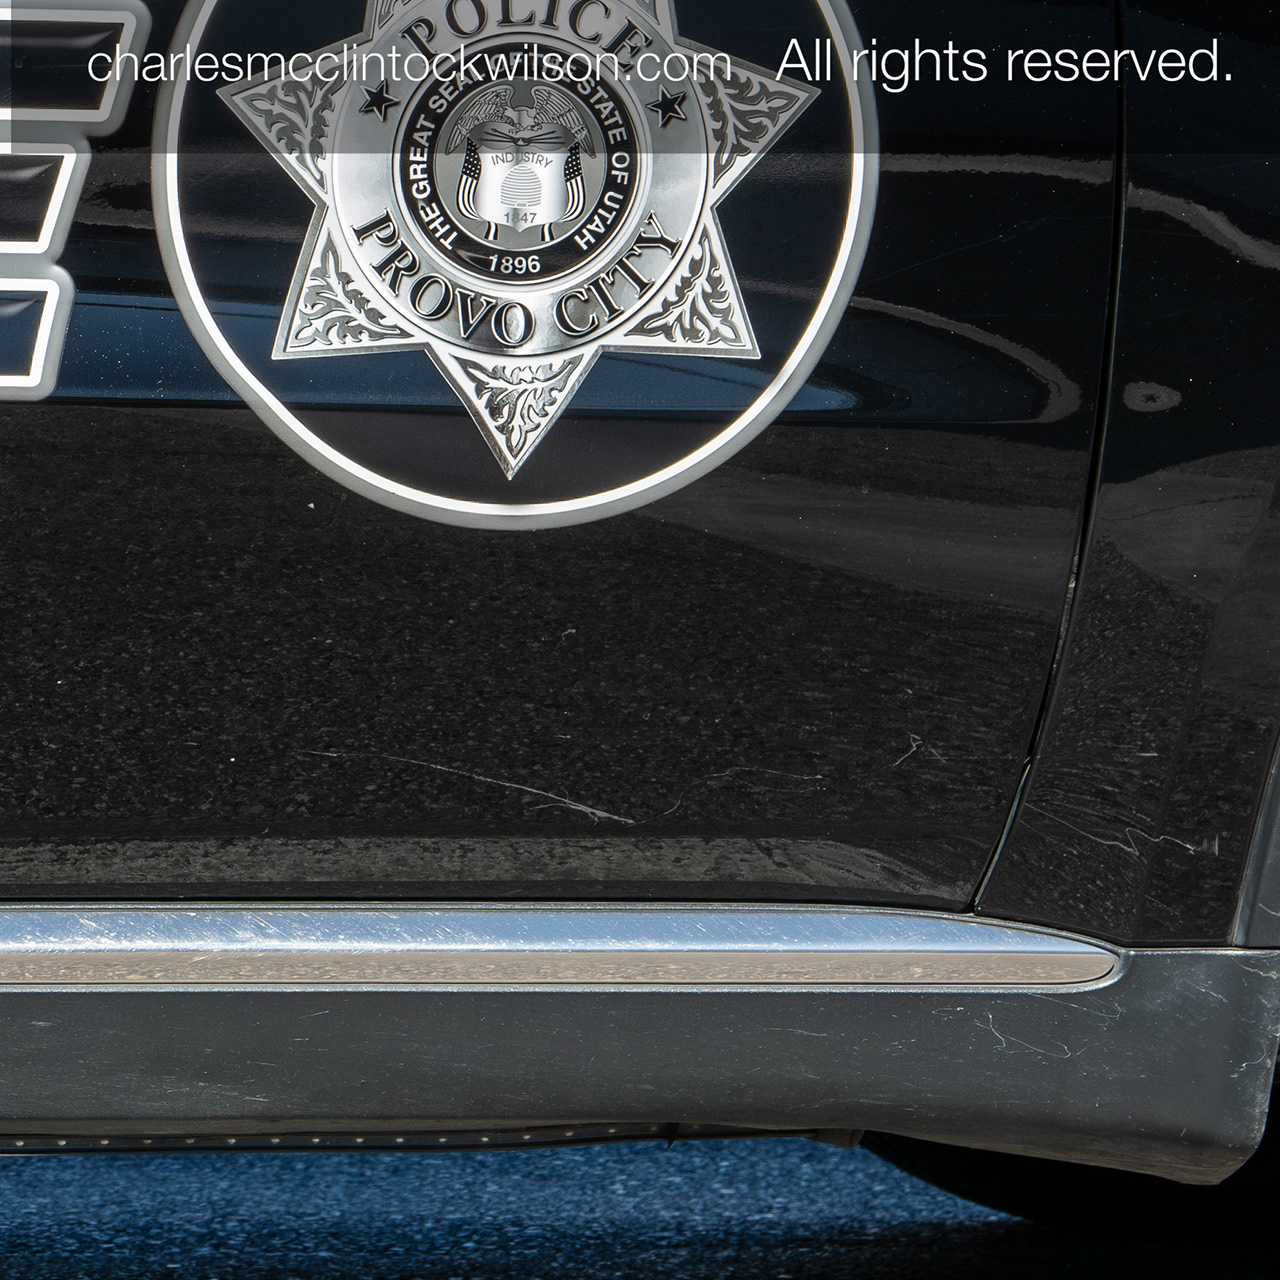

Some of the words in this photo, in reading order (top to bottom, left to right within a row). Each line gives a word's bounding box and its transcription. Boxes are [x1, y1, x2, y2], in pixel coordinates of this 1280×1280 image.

[575, 75, 628, 145] STATE
[408, 114, 436, 200] GREAT
[610, 151, 631, 186] OF
[418, 202, 459, 251] THE
[503, 212, 538, 224] 1847
[573, 190, 625, 251] UTAH
[350, 207, 536, 346] PROVO
[553, 209, 683, 336] CITY
[489, 254, 541, 274] 1896
